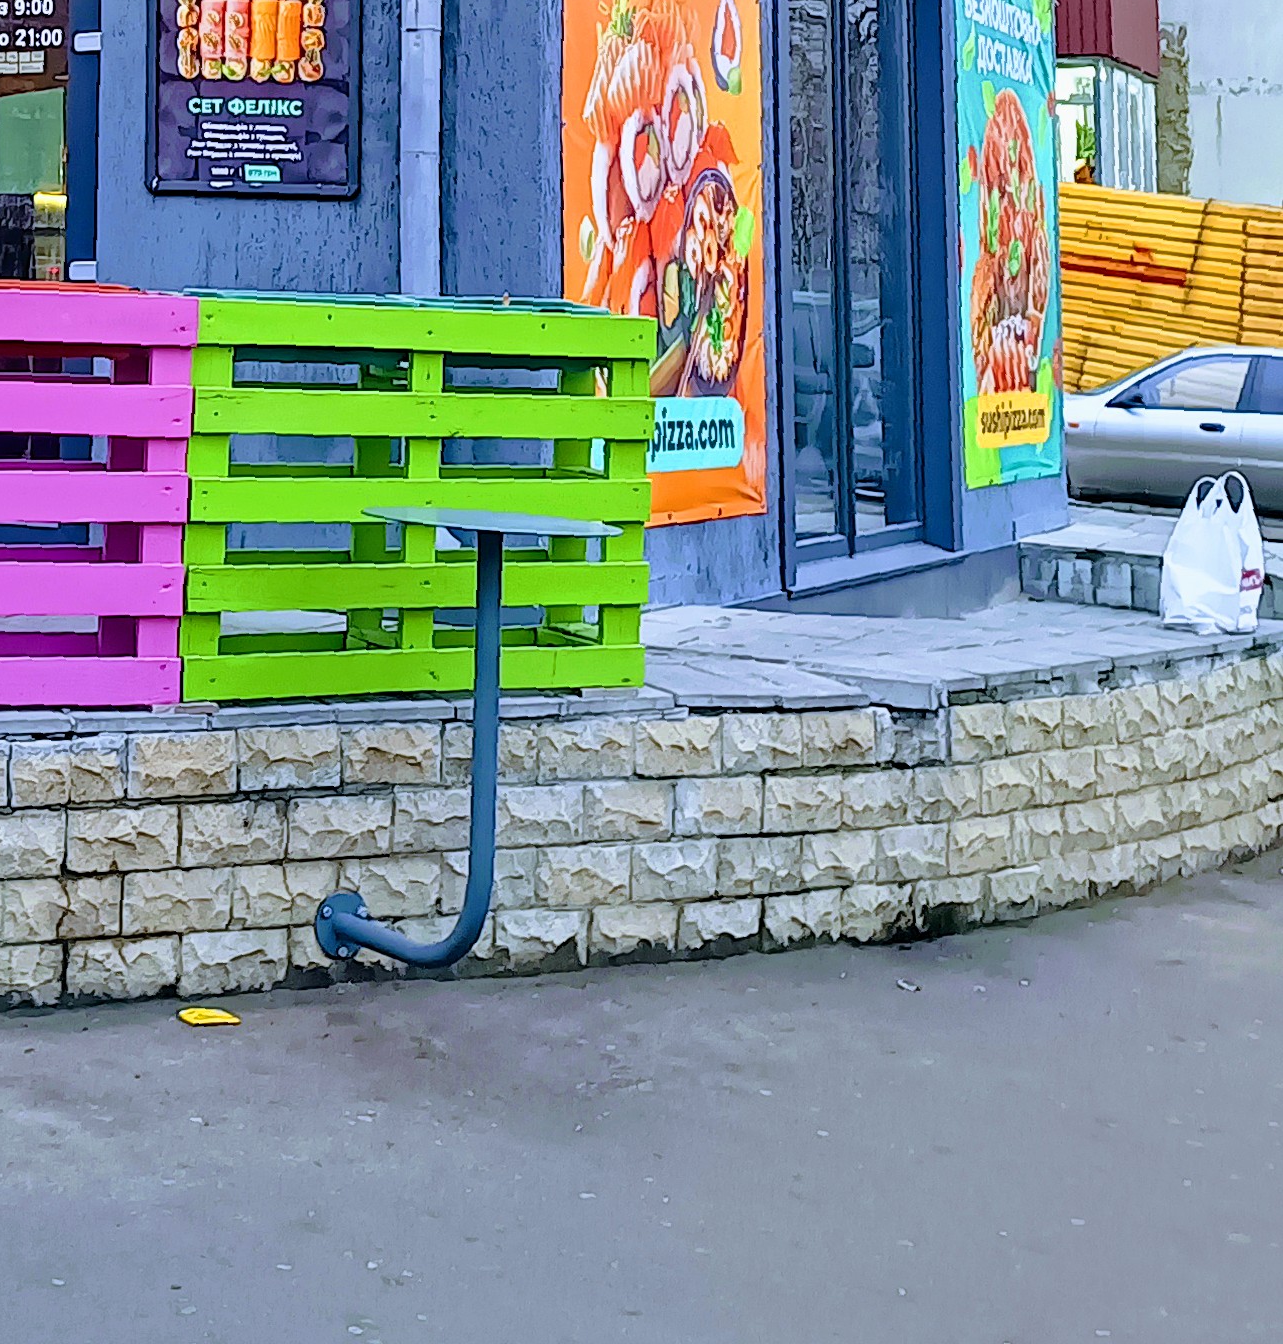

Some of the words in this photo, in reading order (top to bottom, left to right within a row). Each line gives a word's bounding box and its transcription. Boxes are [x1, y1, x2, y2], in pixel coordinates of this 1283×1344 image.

[15, 28, 63, 47] 21:00
[977, 34, 1034, 86] ДОСТАВКА
[188, 97, 224, 114] СЕТ
[227, 97, 302, 116] ФЕЛІКС
[647, 406, 735, 462] pizza.com
